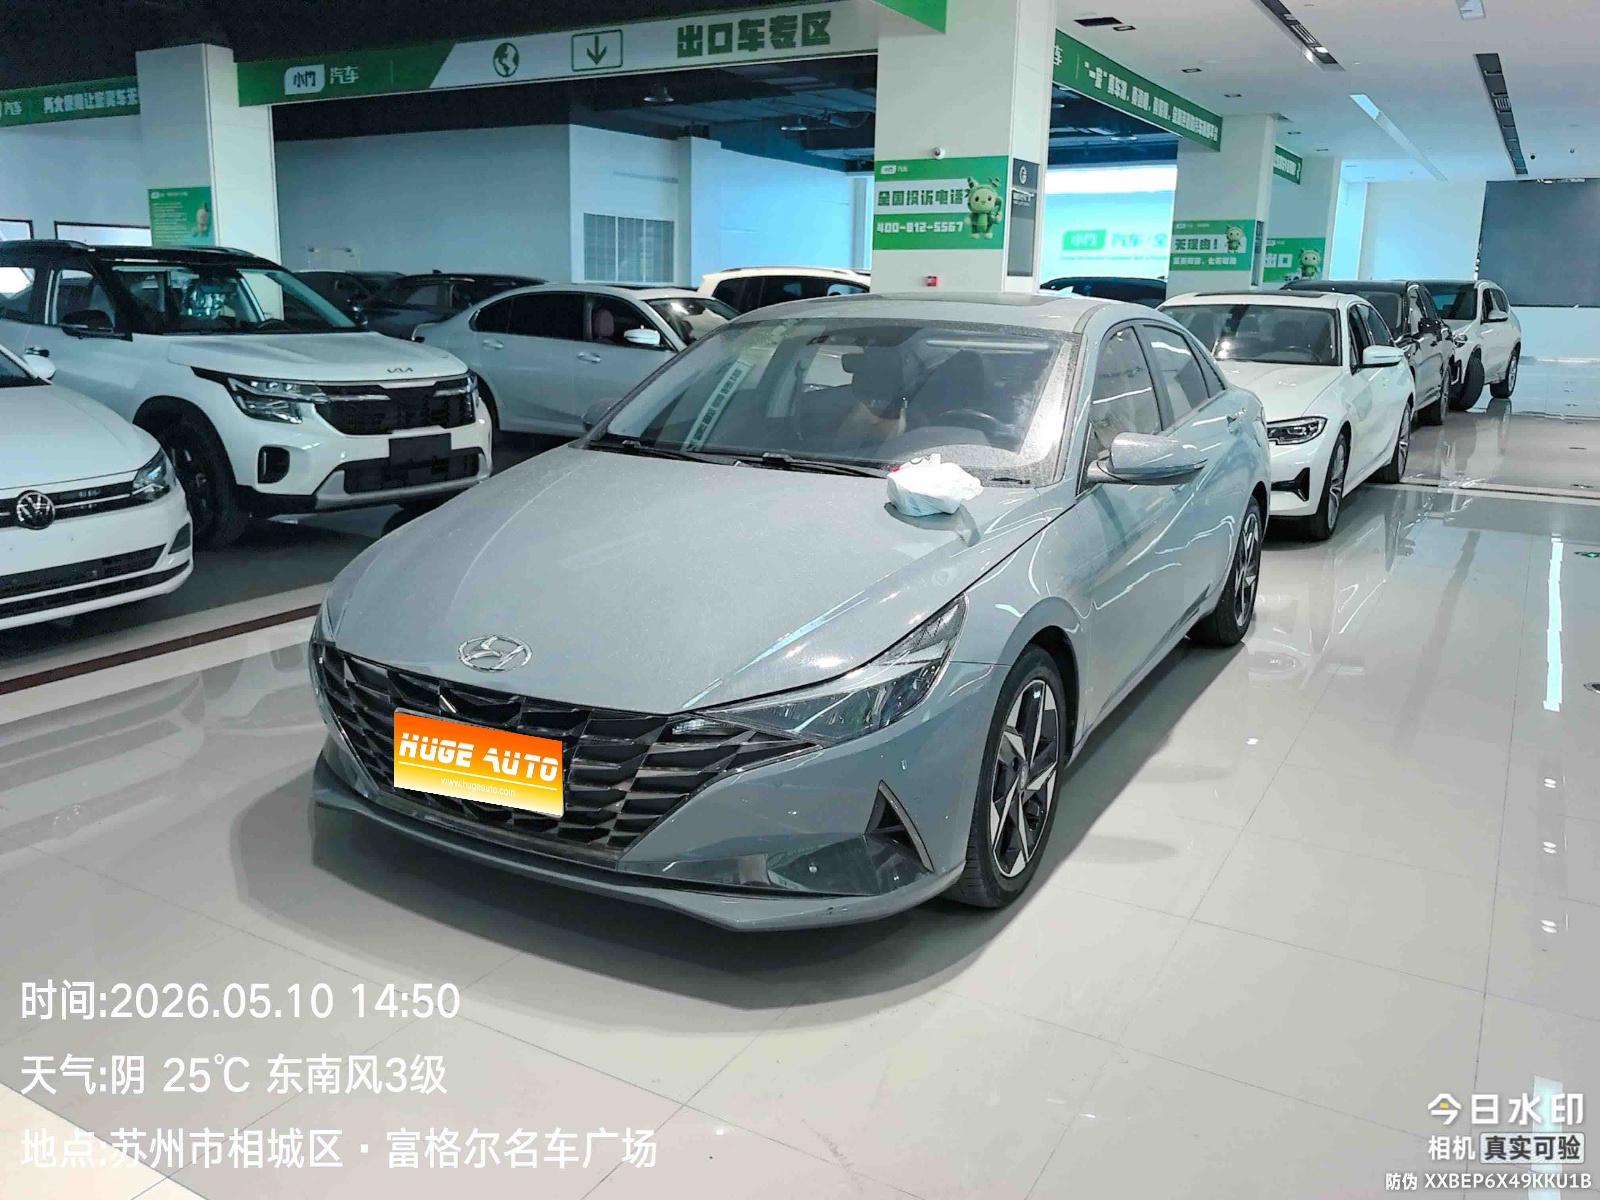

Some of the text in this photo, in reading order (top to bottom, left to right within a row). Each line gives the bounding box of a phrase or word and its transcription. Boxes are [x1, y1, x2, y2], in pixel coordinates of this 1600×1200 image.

[677, 11, 831, 58] 出口车专区
